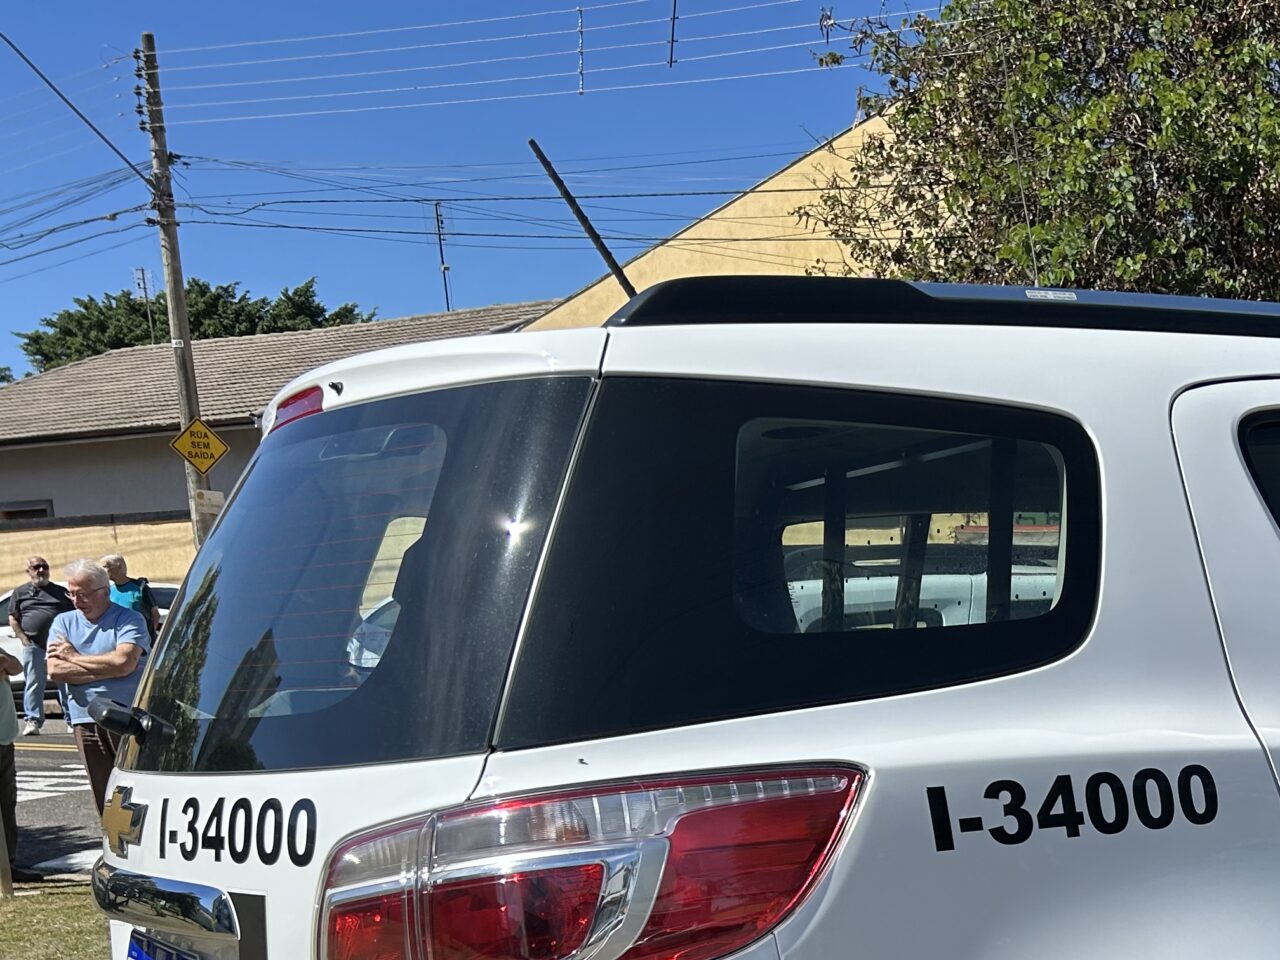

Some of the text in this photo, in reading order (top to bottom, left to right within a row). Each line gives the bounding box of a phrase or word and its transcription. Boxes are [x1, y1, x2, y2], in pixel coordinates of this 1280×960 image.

[190, 430, 209, 440] RUA
[191, 441, 210, 450] SEM
[187, 450, 215, 460] SAÍDA
[926, 764, 1218, 852] I-34000
[159, 797, 317, 868] I-34000
